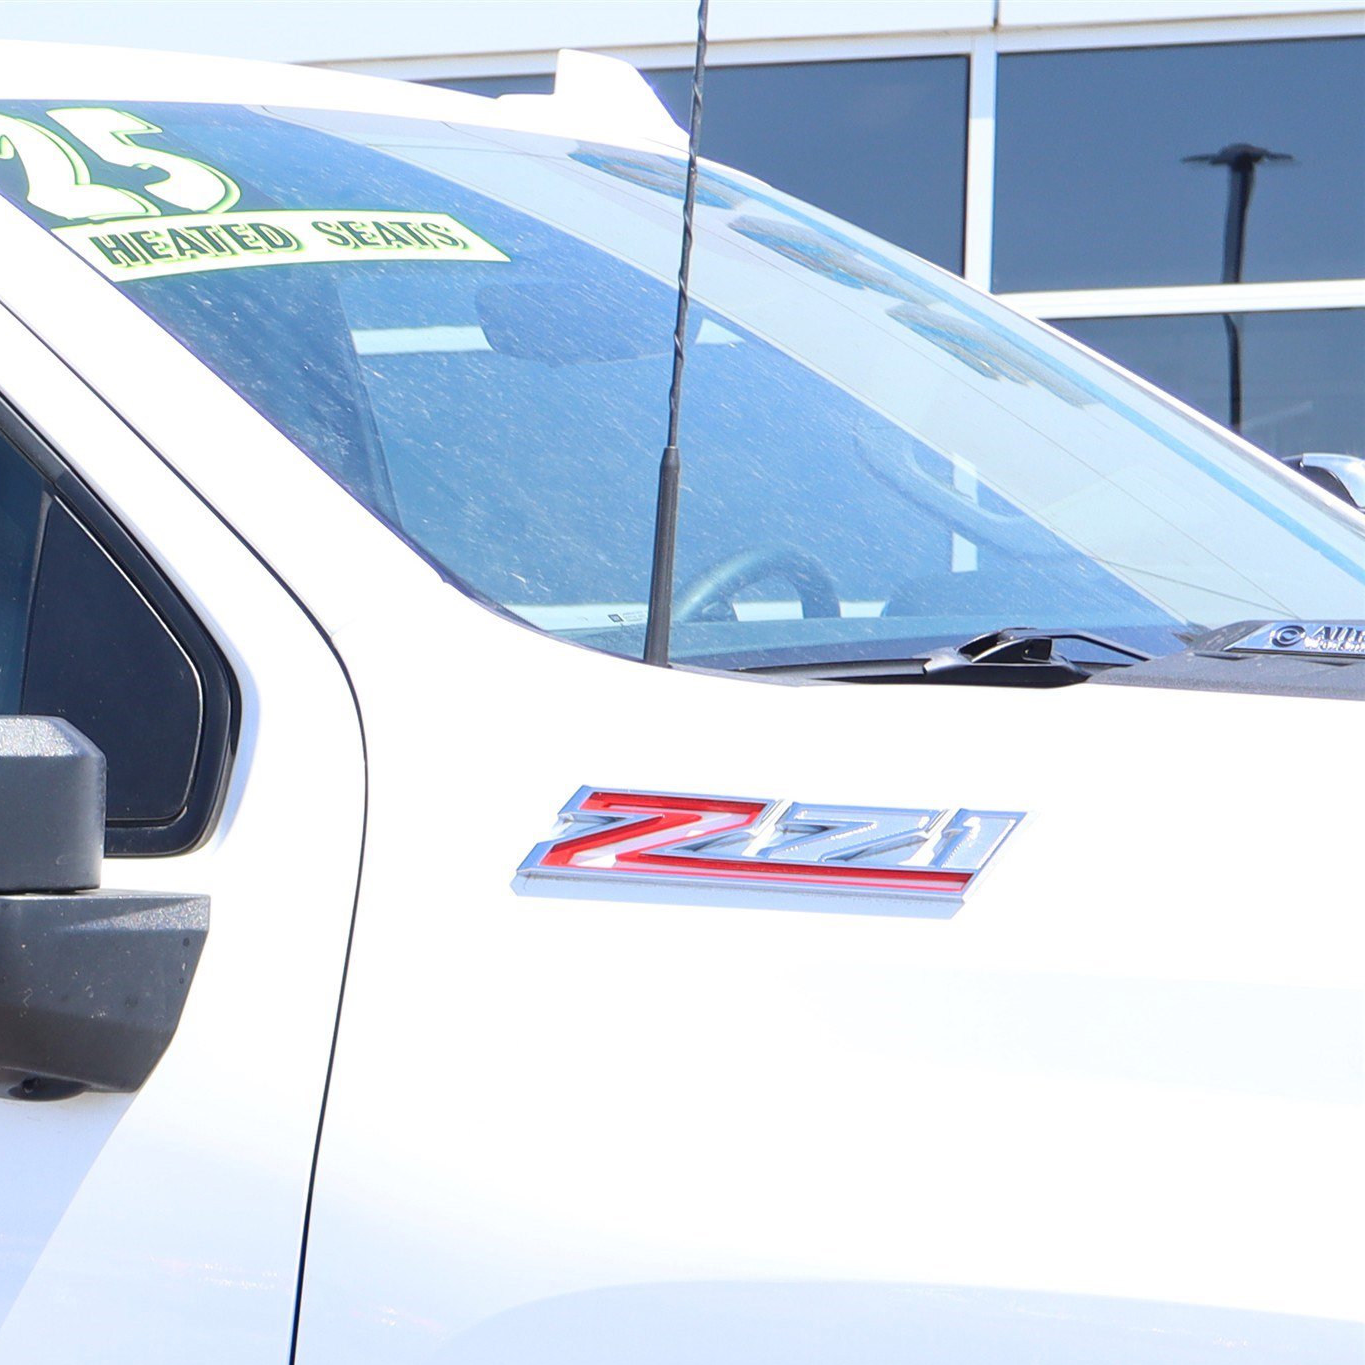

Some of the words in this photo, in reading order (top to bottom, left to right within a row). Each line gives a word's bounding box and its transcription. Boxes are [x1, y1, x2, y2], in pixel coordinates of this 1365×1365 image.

[89, 221, 303, 269] HEATED
[310, 217, 468, 253] SEATS
[512, 785, 1029, 906] Z71
